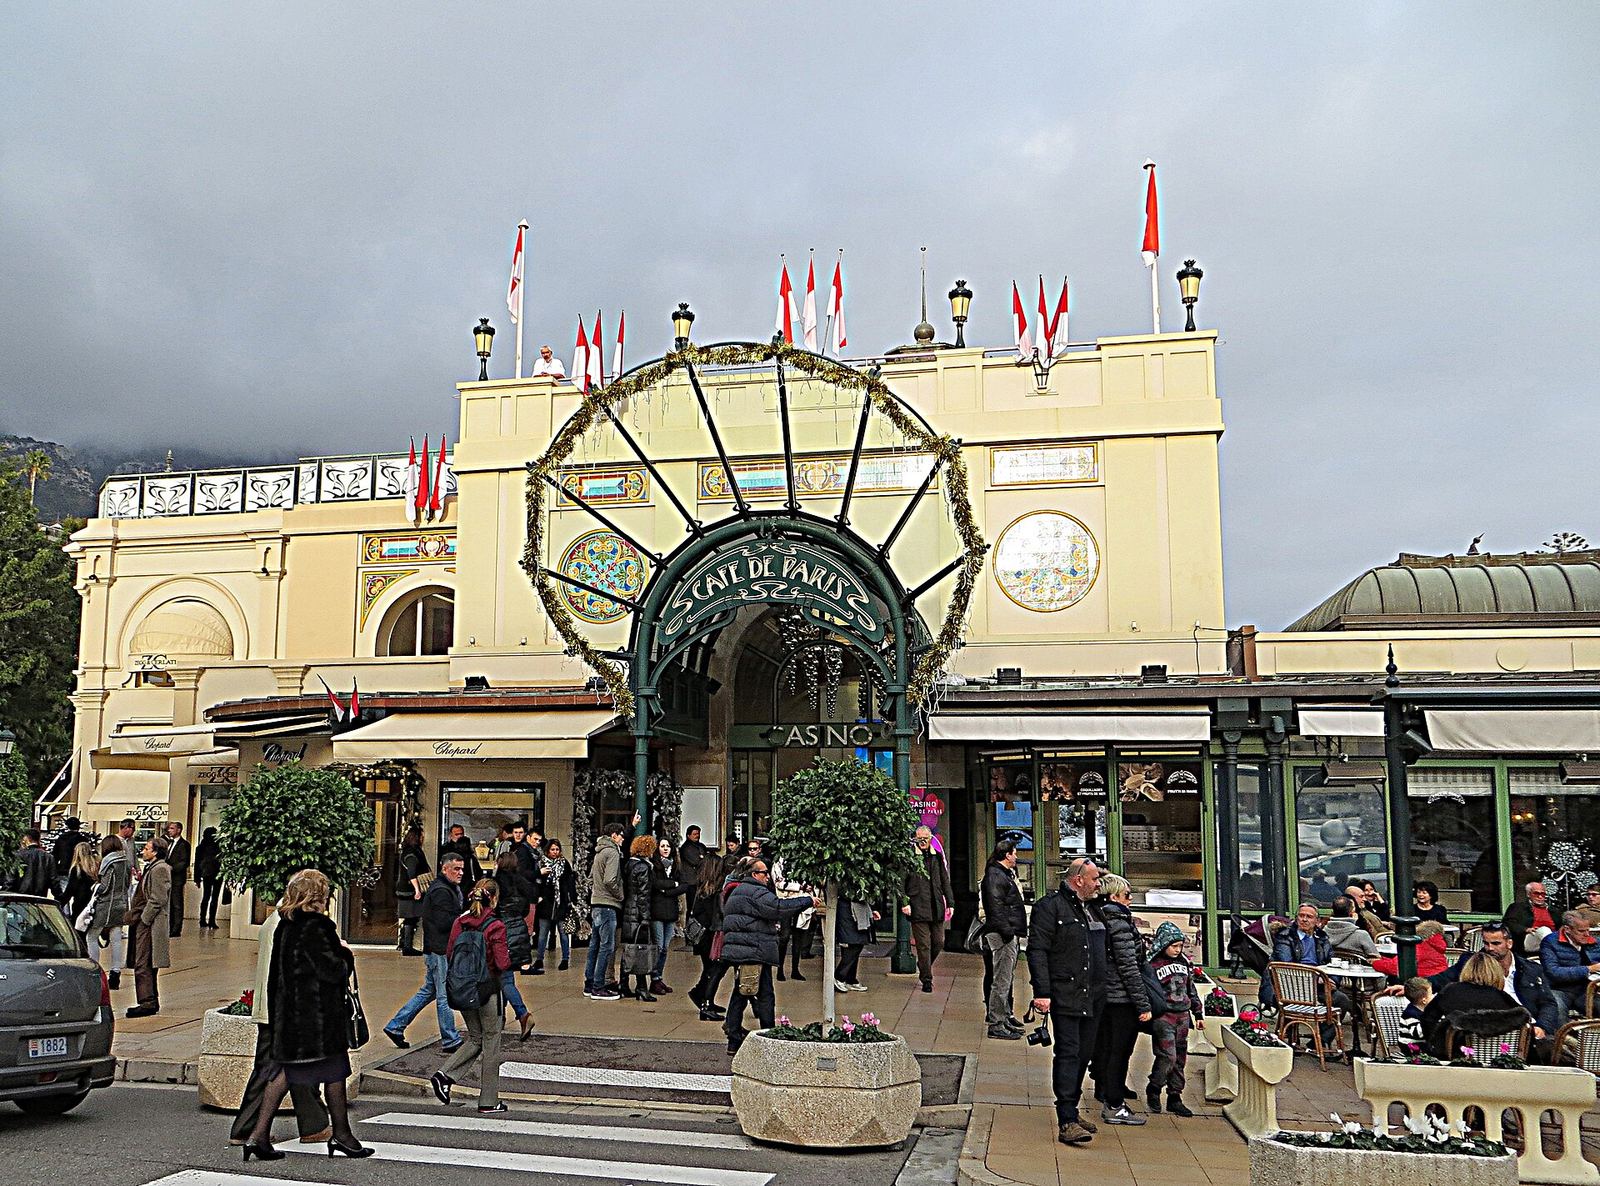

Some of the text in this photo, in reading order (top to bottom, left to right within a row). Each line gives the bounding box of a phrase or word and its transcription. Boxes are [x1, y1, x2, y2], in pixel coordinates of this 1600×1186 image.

[692, 555, 850, 600] CAFE DE PARIS
[144, 737, 174, 751] Chopard
[432, 741, 483, 757] Chopard
[41, 1038, 65, 1053] 1882
